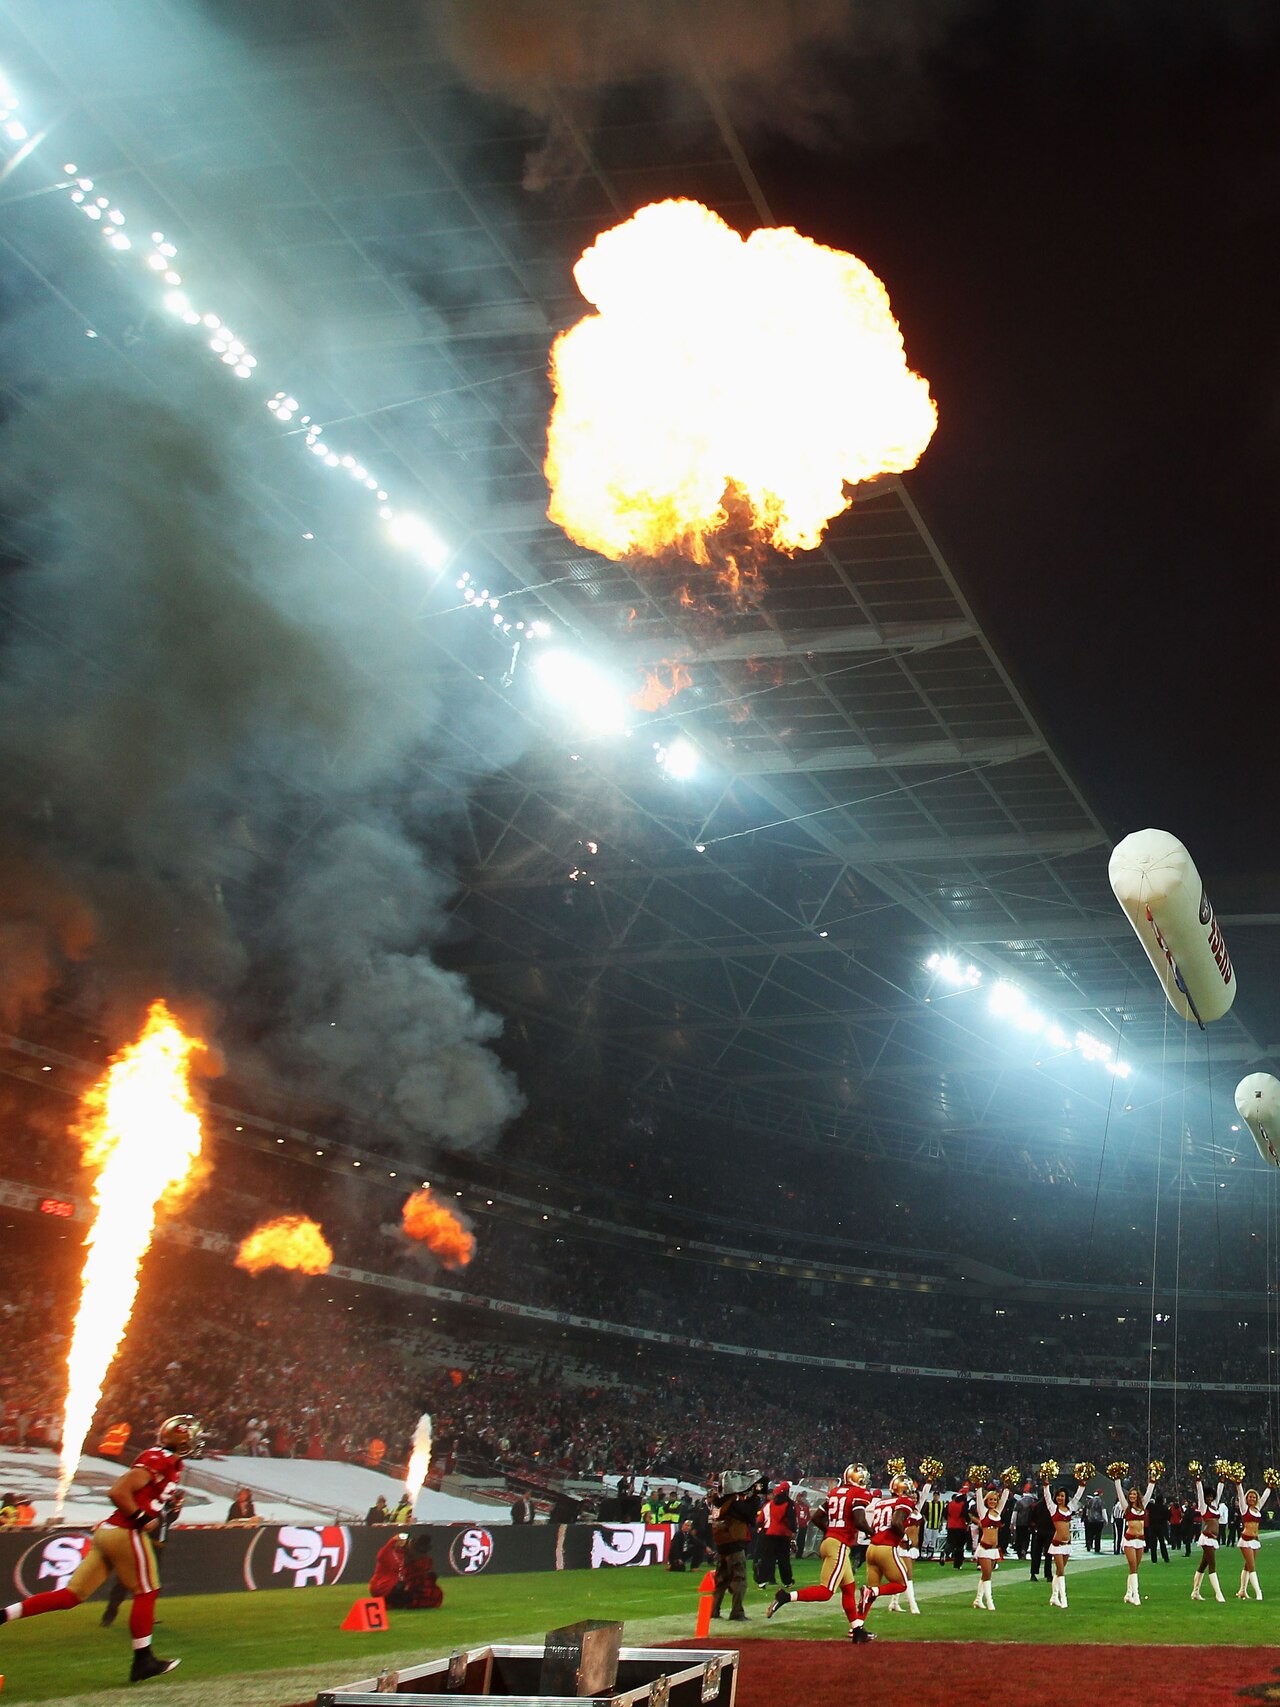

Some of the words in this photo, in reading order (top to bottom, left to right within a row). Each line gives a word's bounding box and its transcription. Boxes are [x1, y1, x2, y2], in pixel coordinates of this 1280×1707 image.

[957, 1370, 971, 1379] VISA
[1122, 1380, 1148, 1388] Canon
[1187, 1382, 1202, 1390] VISA
[827, 1496, 847, 1528] 21
[365, 1602, 382, 1628] G
